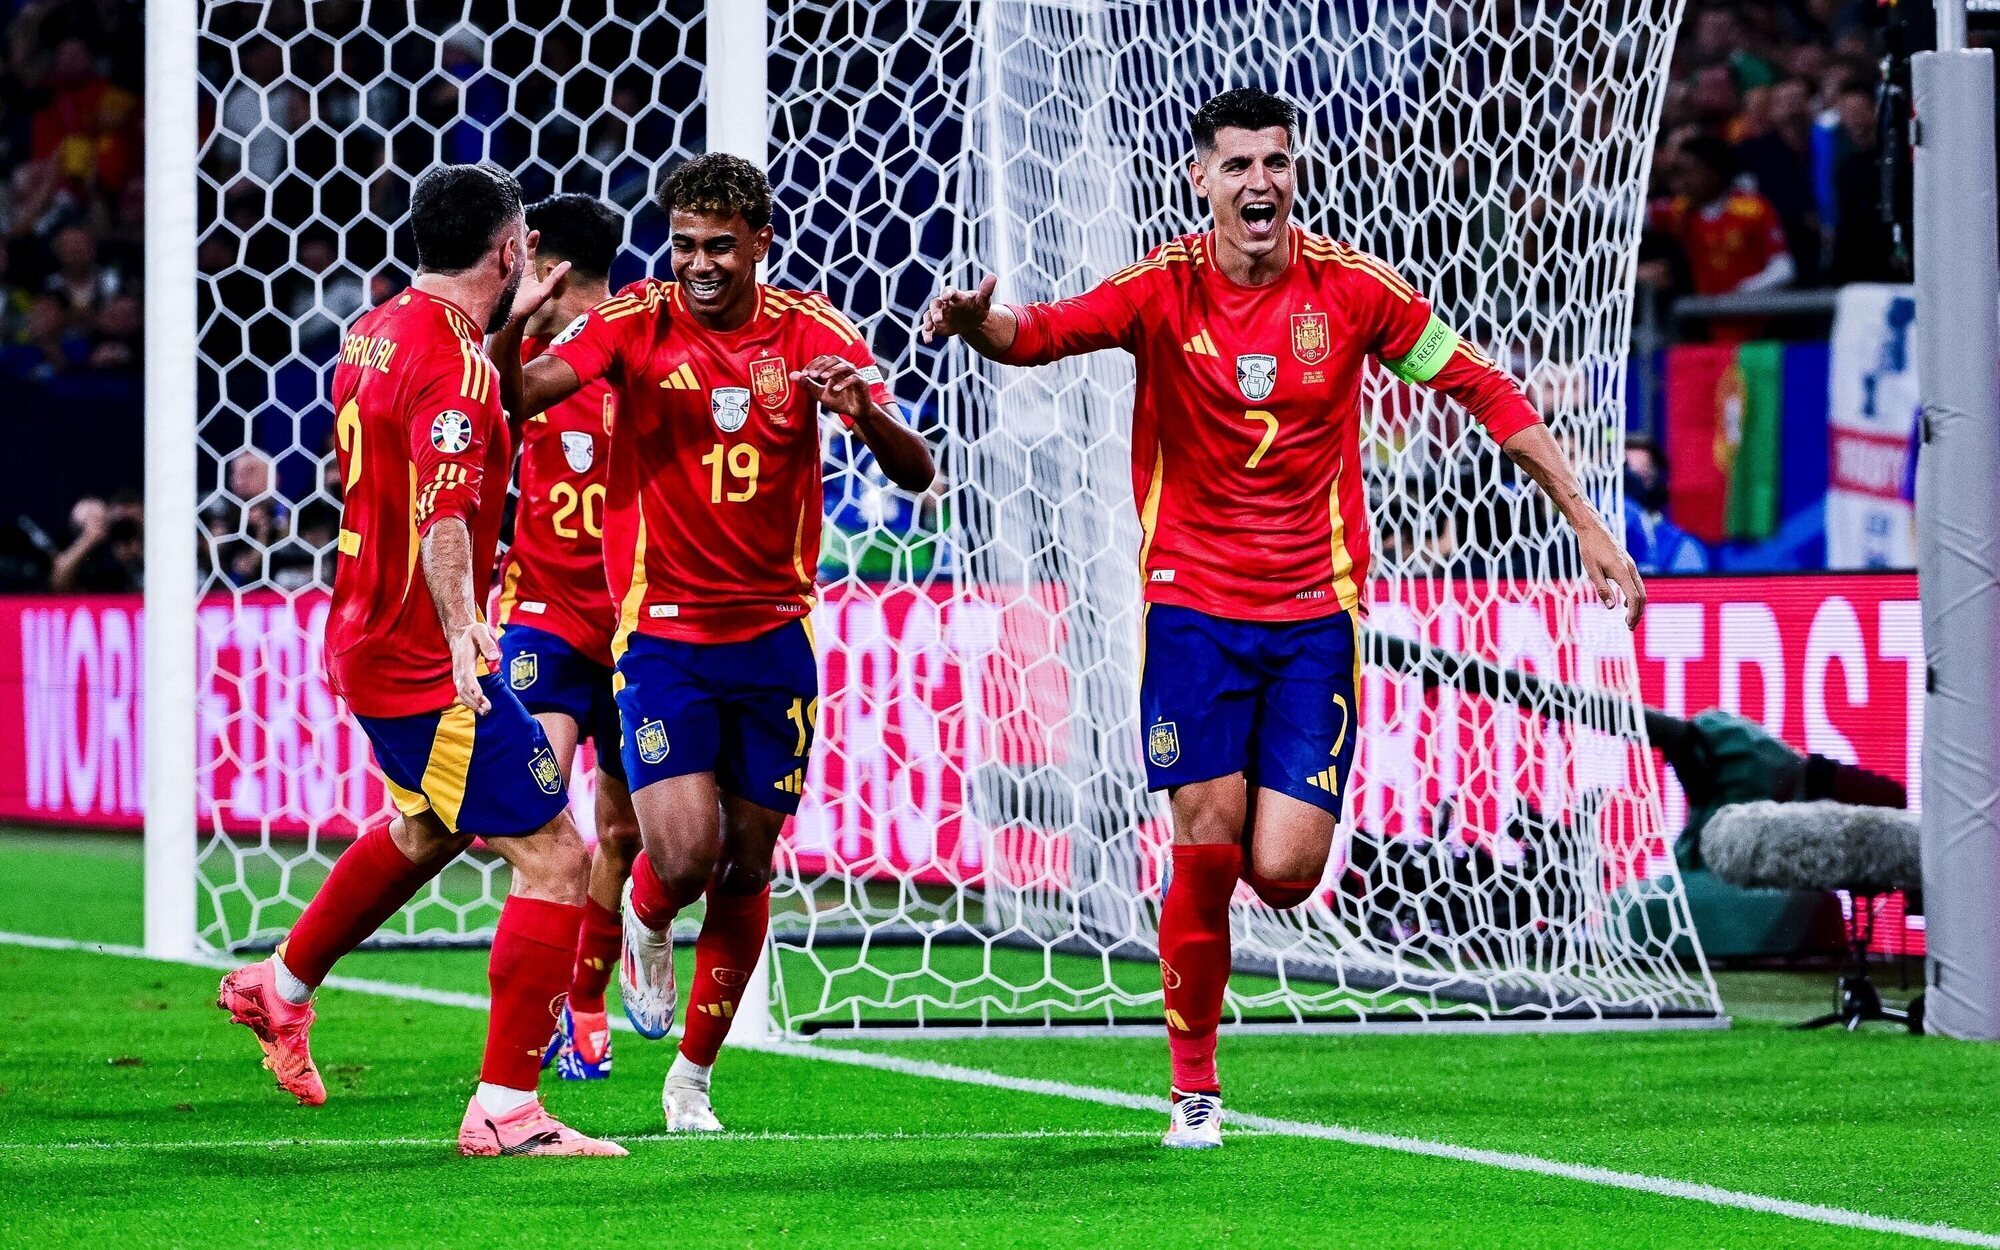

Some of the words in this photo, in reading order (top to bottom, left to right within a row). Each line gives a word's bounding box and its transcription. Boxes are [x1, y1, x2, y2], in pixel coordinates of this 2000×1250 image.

[1244, 410, 1279, 468] 7
[336, 398, 362, 558] 2
[702, 443, 760, 503] 19
[550, 481, 606, 538] 20
[1329, 693, 1348, 757] 7
